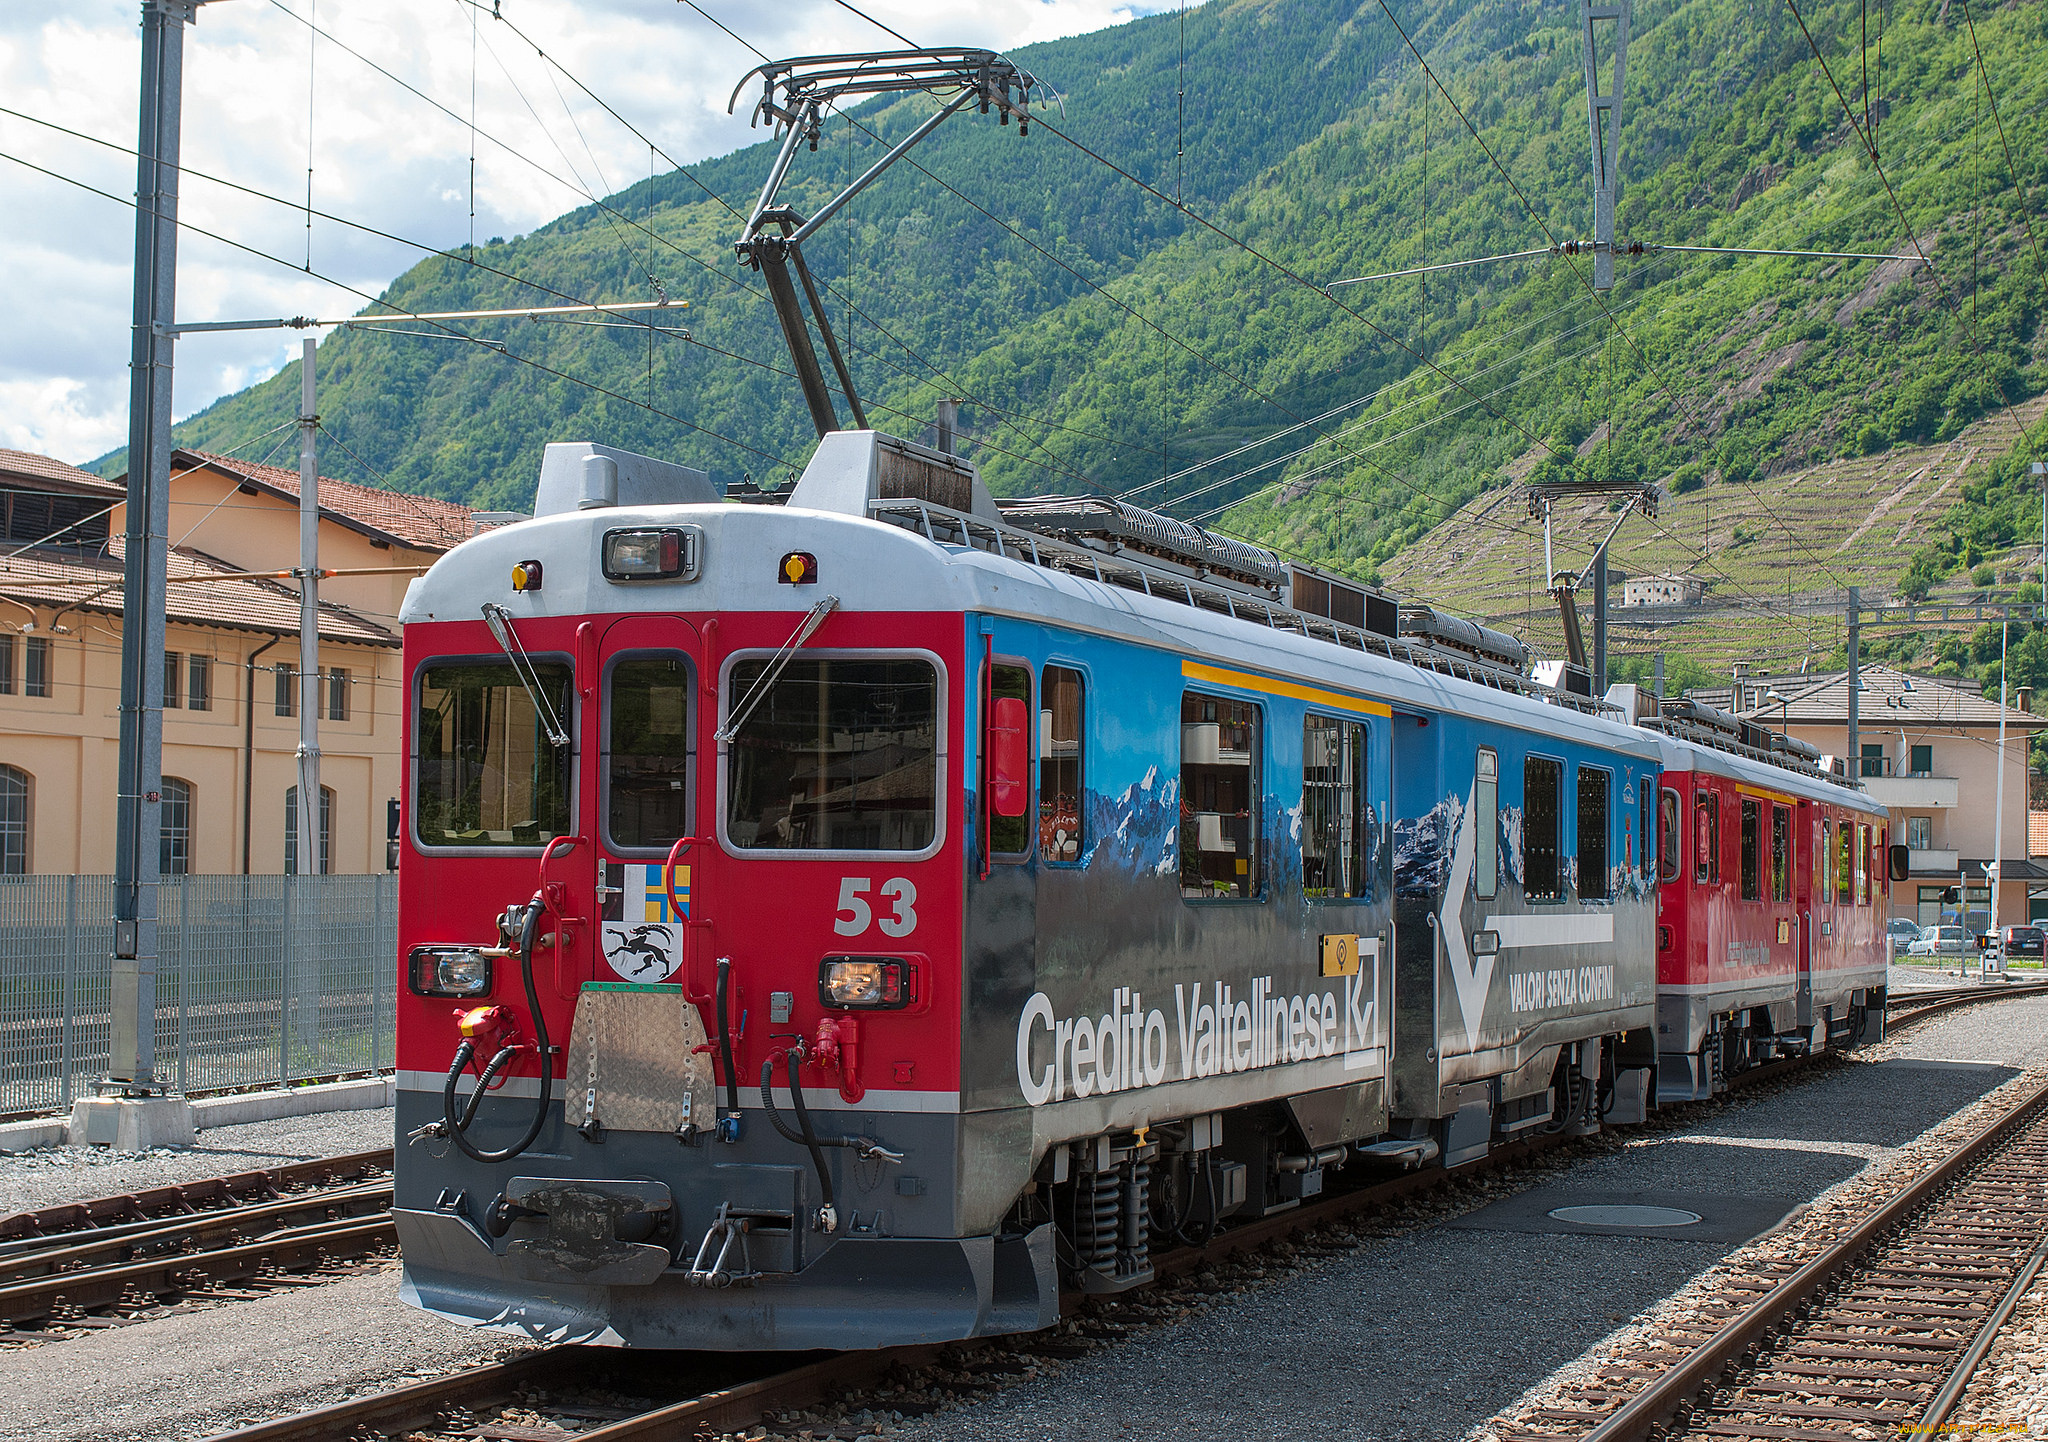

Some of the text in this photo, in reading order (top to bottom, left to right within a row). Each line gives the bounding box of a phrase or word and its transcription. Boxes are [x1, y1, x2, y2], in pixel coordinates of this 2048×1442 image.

[833, 877, 918, 937] 53
[1509, 971, 1545, 1013] VALORI
[1547, 968, 1577, 1009] SENZA
[1578, 965, 1614, 1004] CONFINI
[1016, 975, 1338, 1107] Credito Valtellinese
